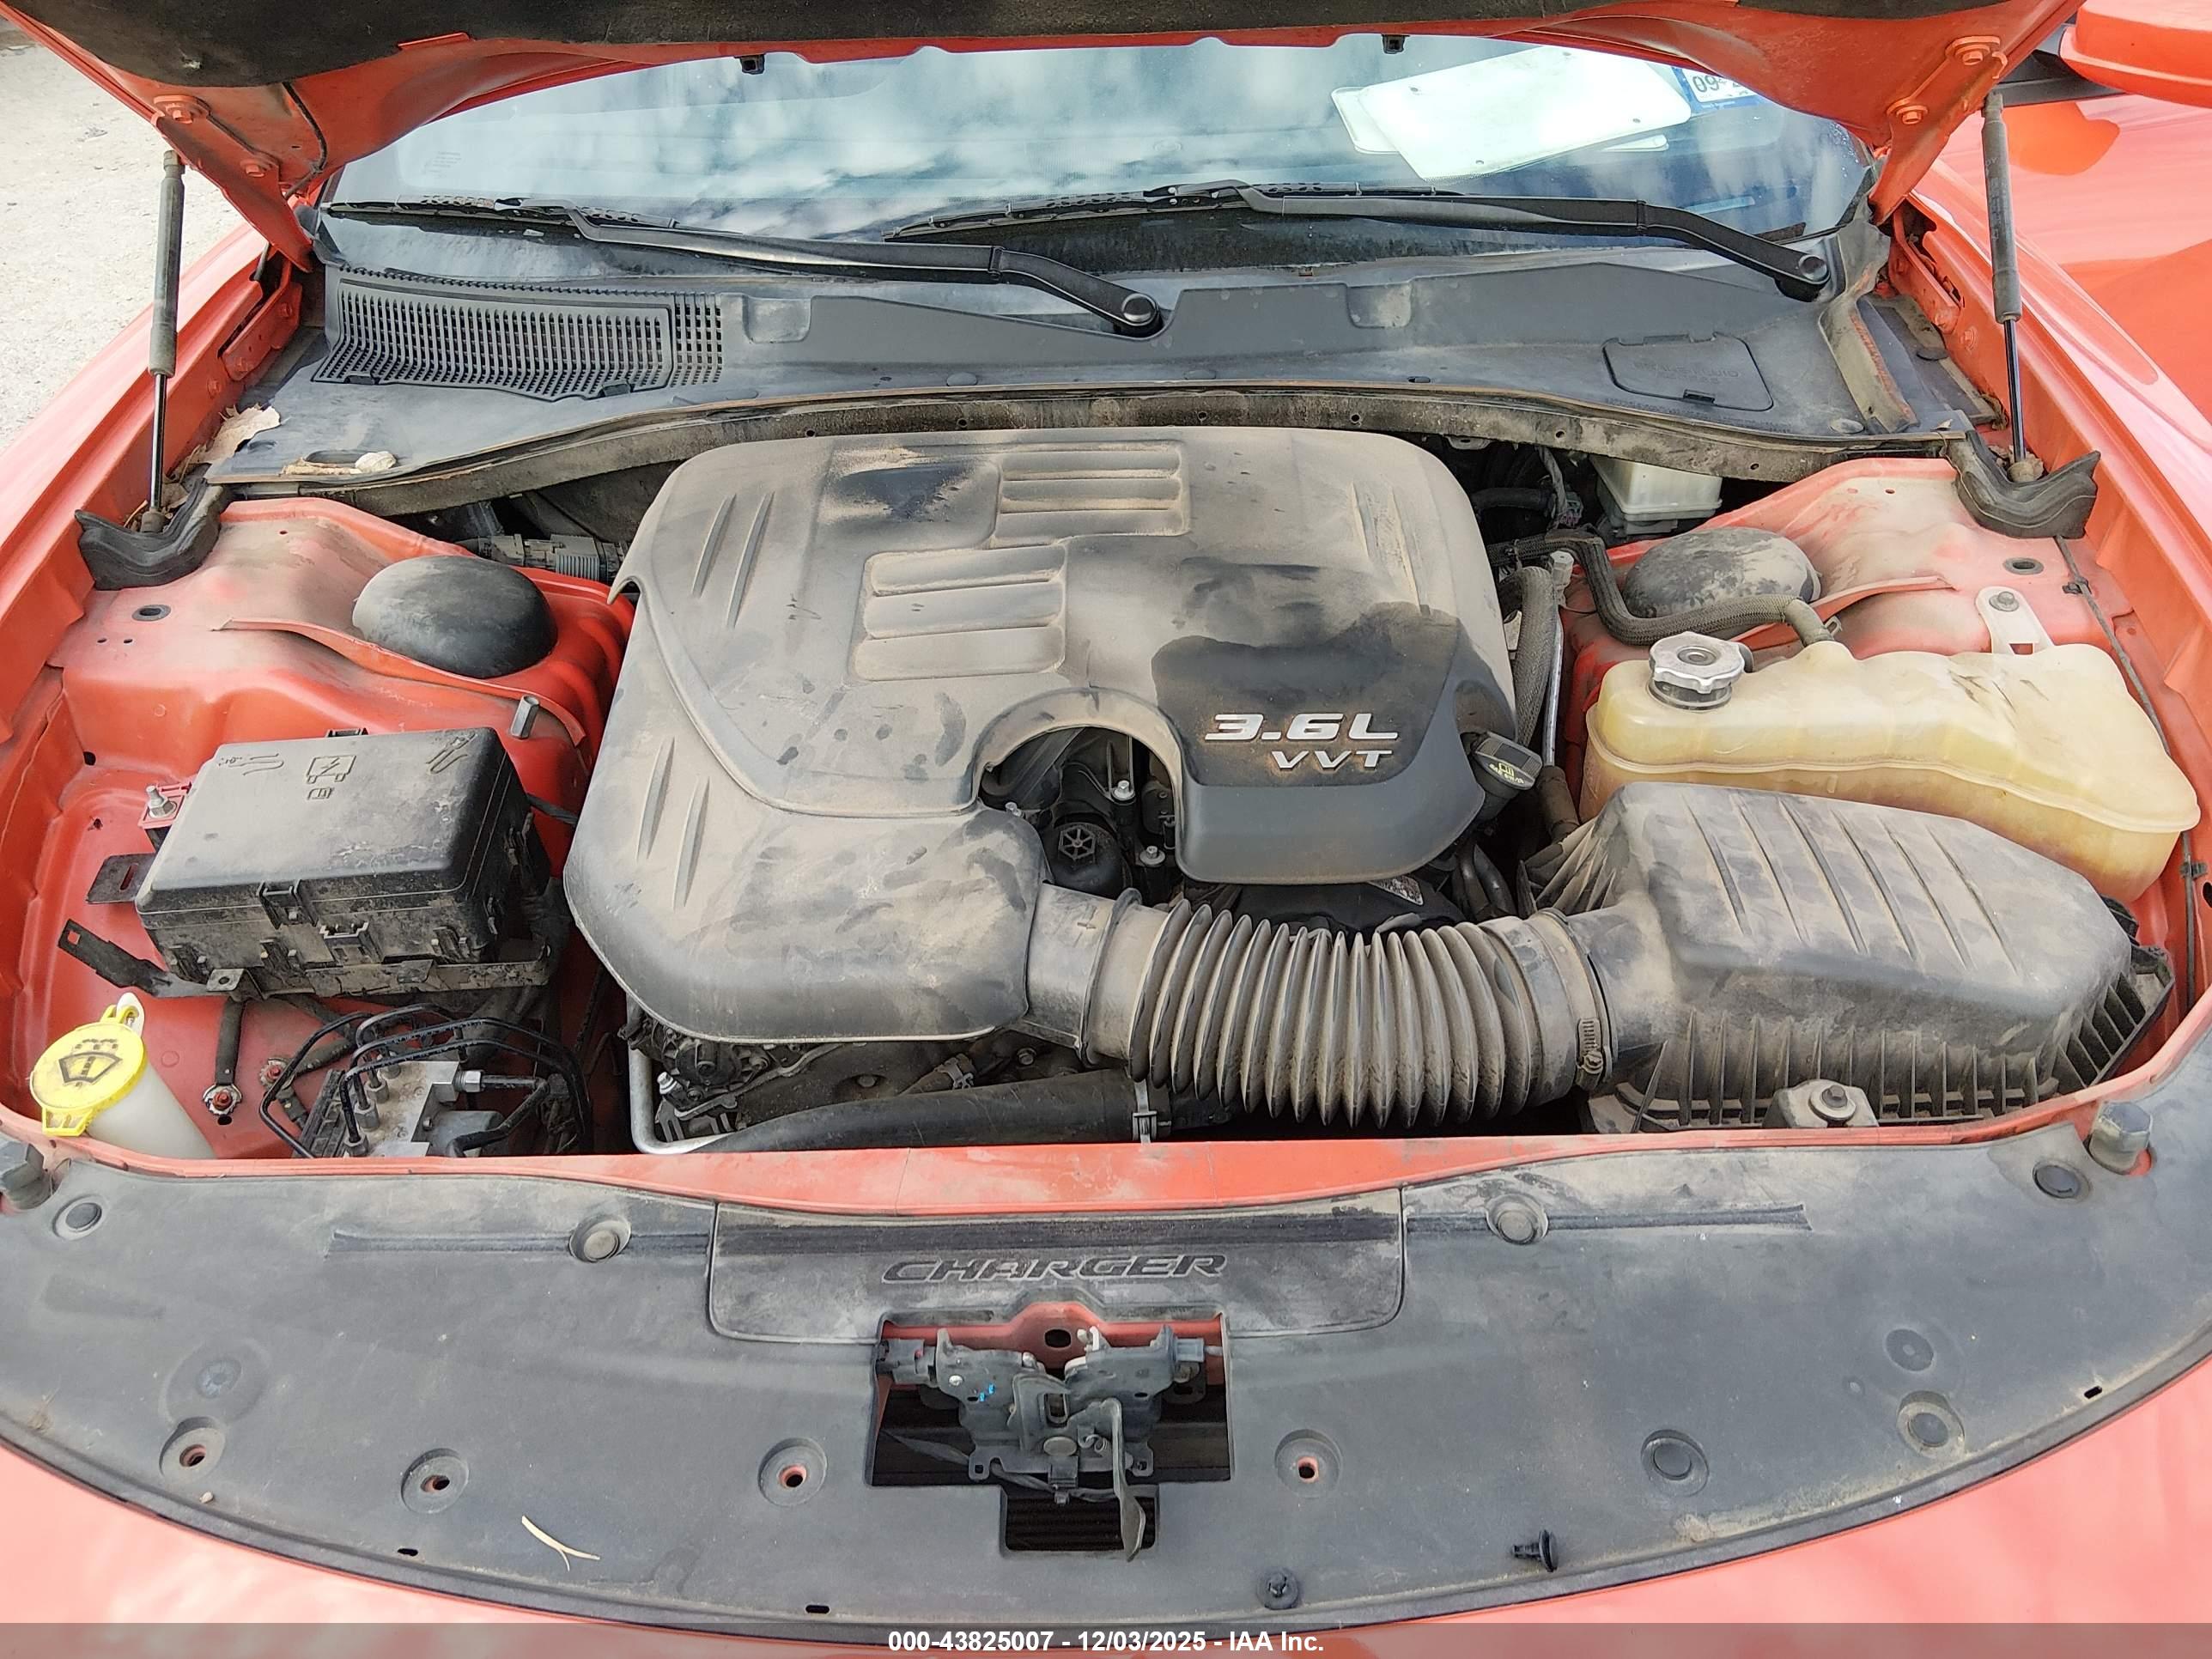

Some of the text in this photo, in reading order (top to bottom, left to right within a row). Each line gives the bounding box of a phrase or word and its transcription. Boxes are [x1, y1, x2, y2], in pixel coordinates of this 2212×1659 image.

[1205, 713, 1399, 740] 3.6L
[1271, 750, 1393, 769] VVT
[881, 1255, 1228, 1284] CHARGER
